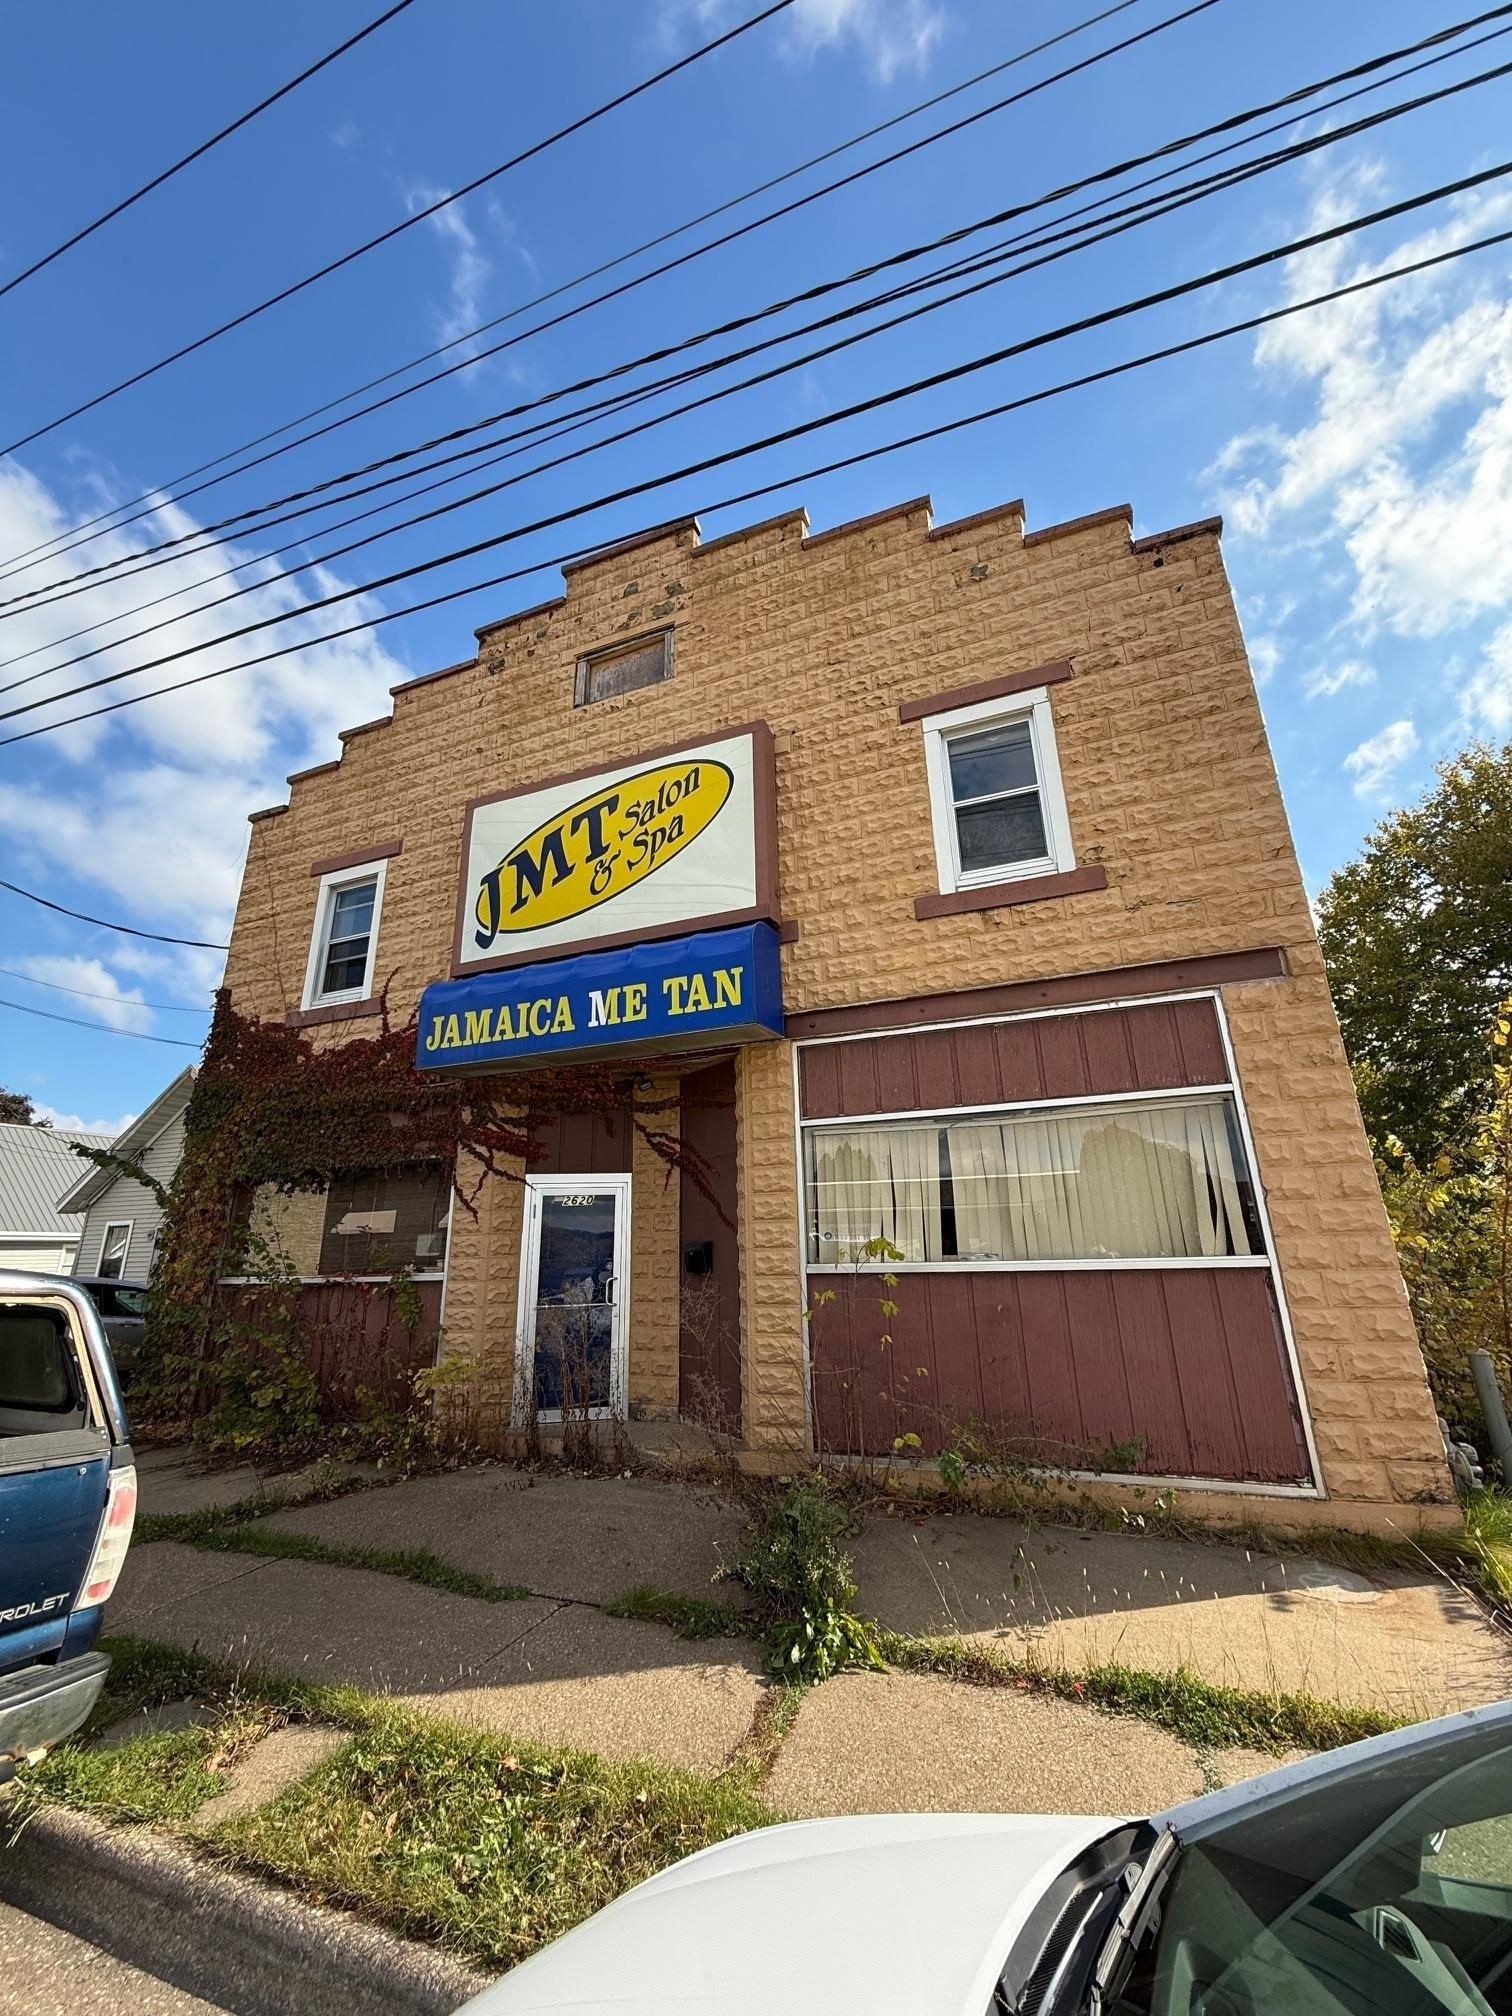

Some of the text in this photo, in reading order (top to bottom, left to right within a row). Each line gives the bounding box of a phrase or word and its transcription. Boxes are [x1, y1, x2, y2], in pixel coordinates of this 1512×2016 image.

[474, 766, 701, 950] JMT Salon
[589, 814, 685, 896] & Spa
[426, 967, 744, 1051] JAMAICA ME TAN
[563, 1195, 594, 1206] 2620
